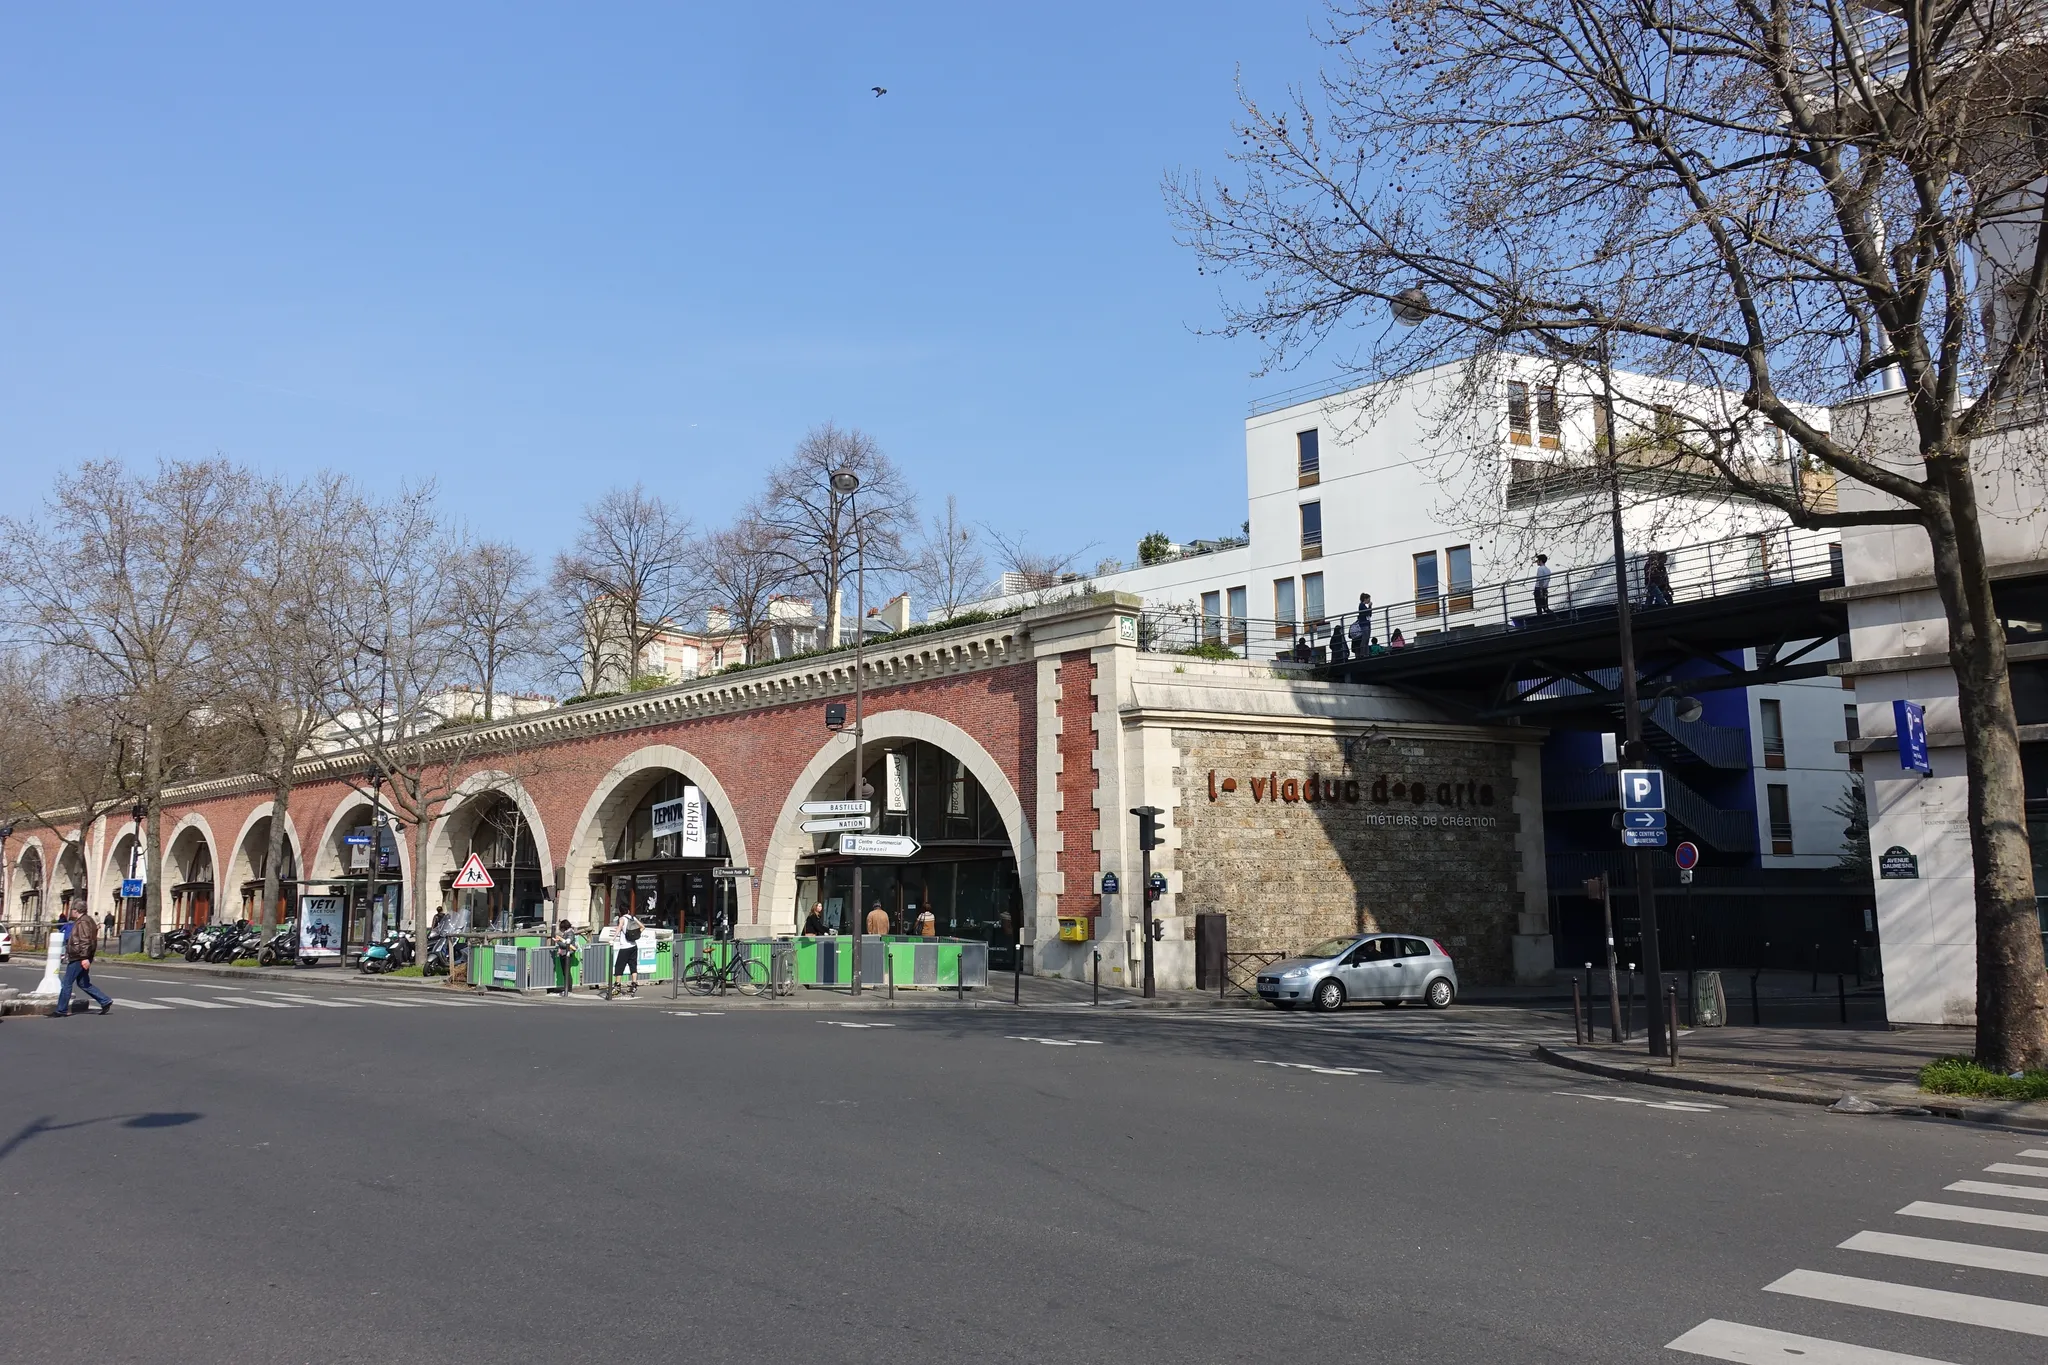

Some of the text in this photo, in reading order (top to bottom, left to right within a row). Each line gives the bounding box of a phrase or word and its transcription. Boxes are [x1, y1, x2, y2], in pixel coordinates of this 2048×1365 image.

[1250, 771, 1360, 804] viaduc
[1436, 778, 1494, 807] arts
[1633, 778, 1652, 803] P
[654, 802, 684, 826] ZEPHYR
[686, 801, 699, 842] ZEPHYR
